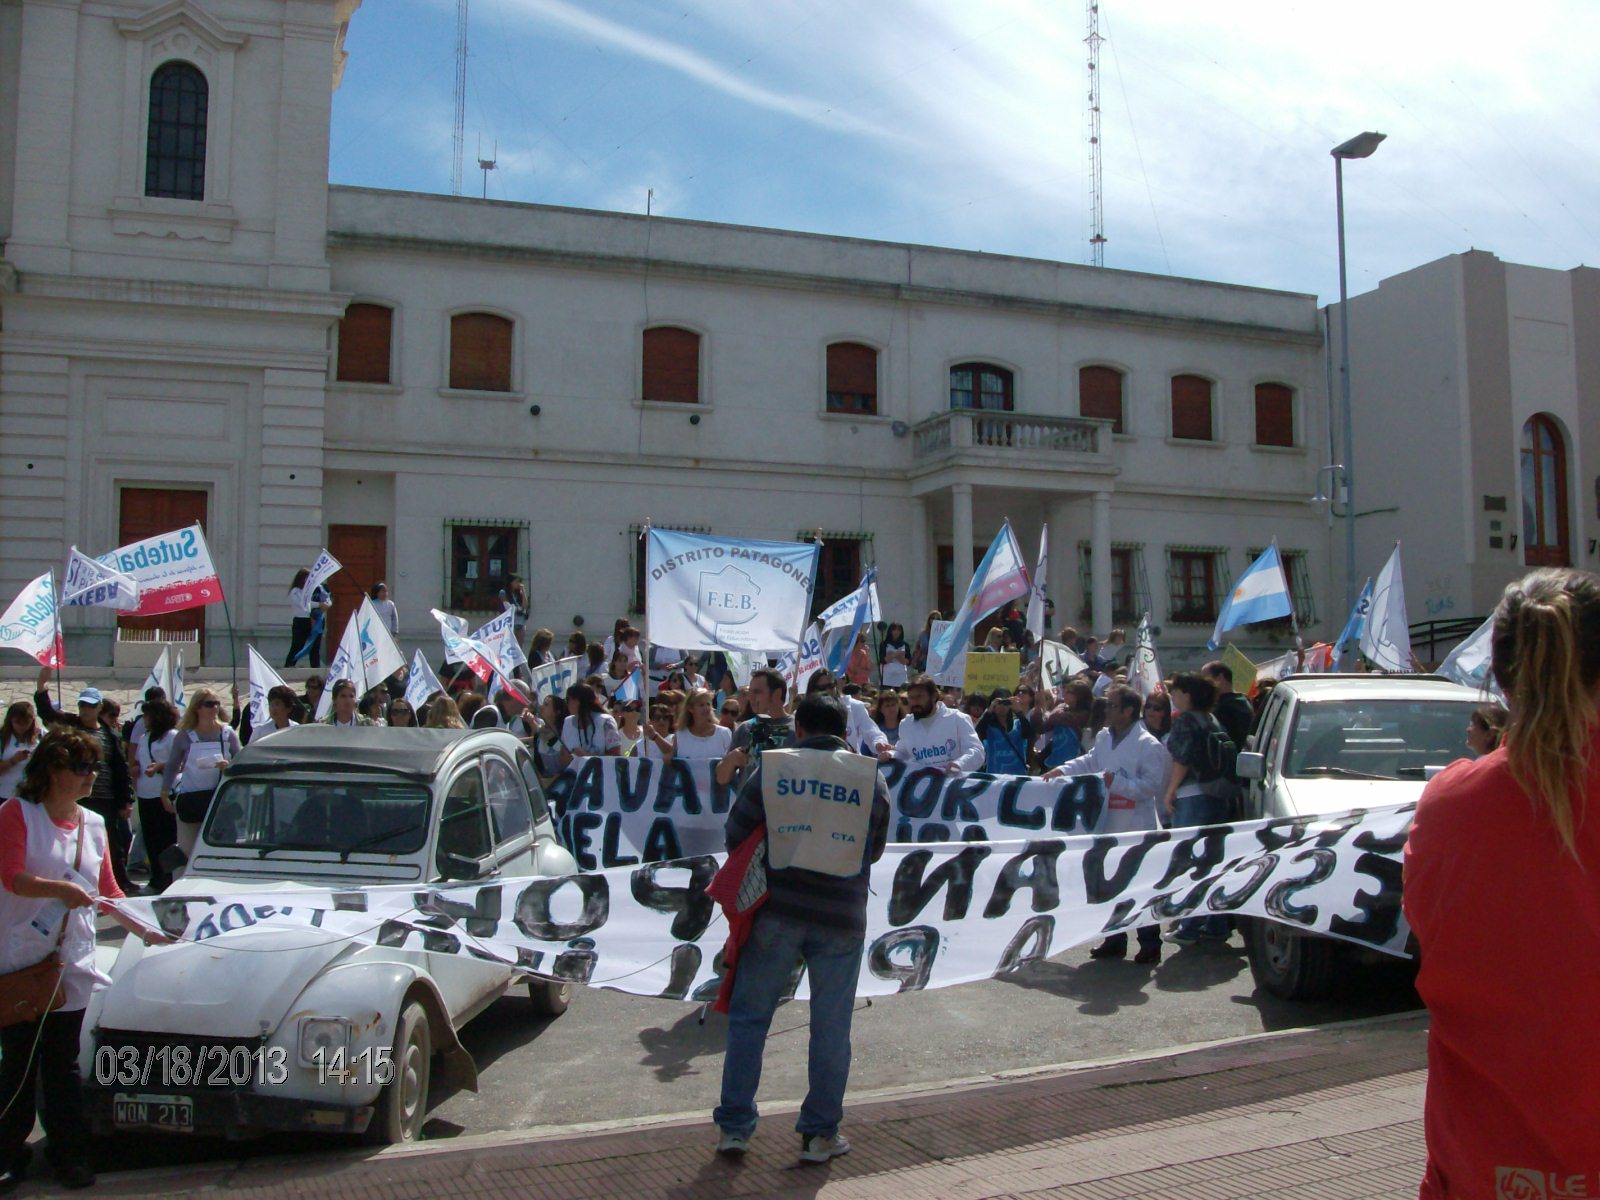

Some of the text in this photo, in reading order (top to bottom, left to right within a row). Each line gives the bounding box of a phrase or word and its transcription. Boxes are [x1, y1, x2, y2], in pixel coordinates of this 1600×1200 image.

[651, 546, 814, 595] DISTRITO PATAGONES
[706, 591, 757, 611] F.E.B.
[911, 744, 947, 761] Suteba
[776, 778, 861, 807] SUTEBA
[831, 831, 856, 842] CTA
